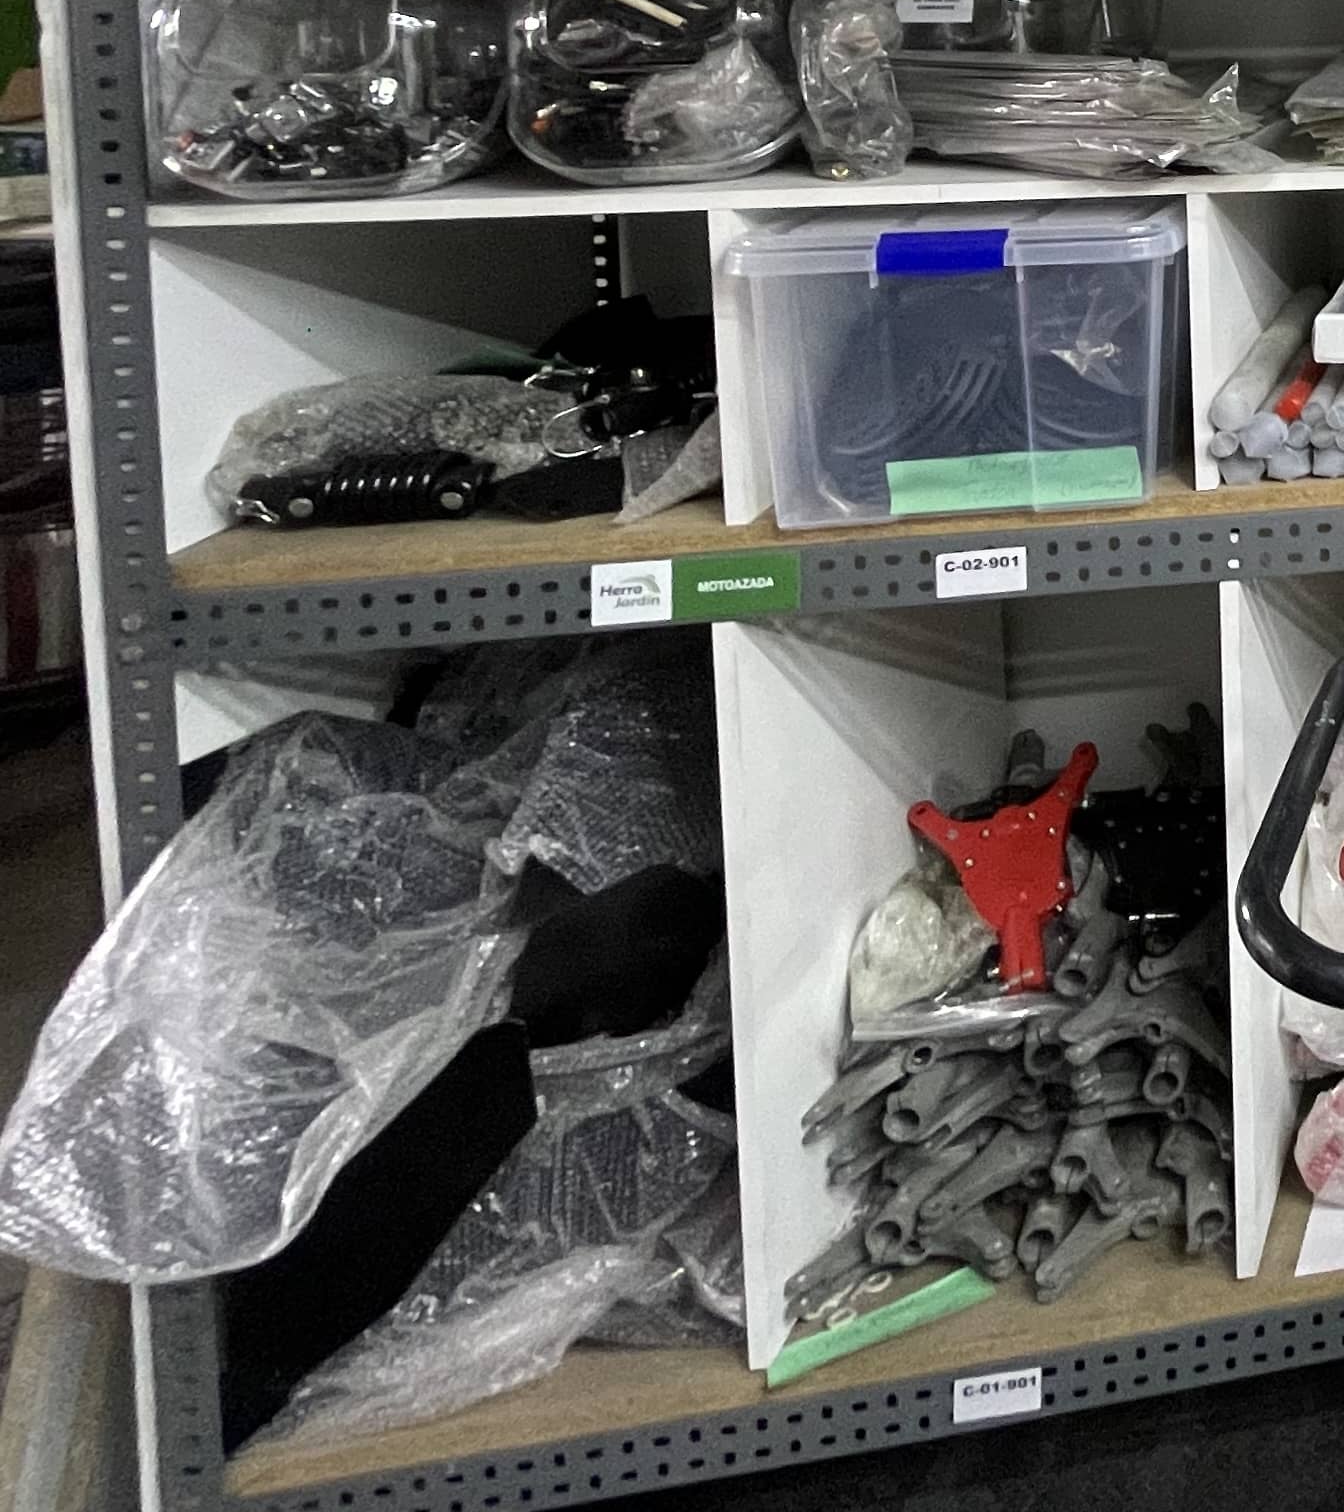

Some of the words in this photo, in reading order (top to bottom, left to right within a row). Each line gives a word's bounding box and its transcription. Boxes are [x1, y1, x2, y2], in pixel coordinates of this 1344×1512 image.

[944, 554, 1020, 573] C-02-901
[697, 576, 775, 592] MOTOAZADA
[963, 1375, 1037, 1398] C-01-901
